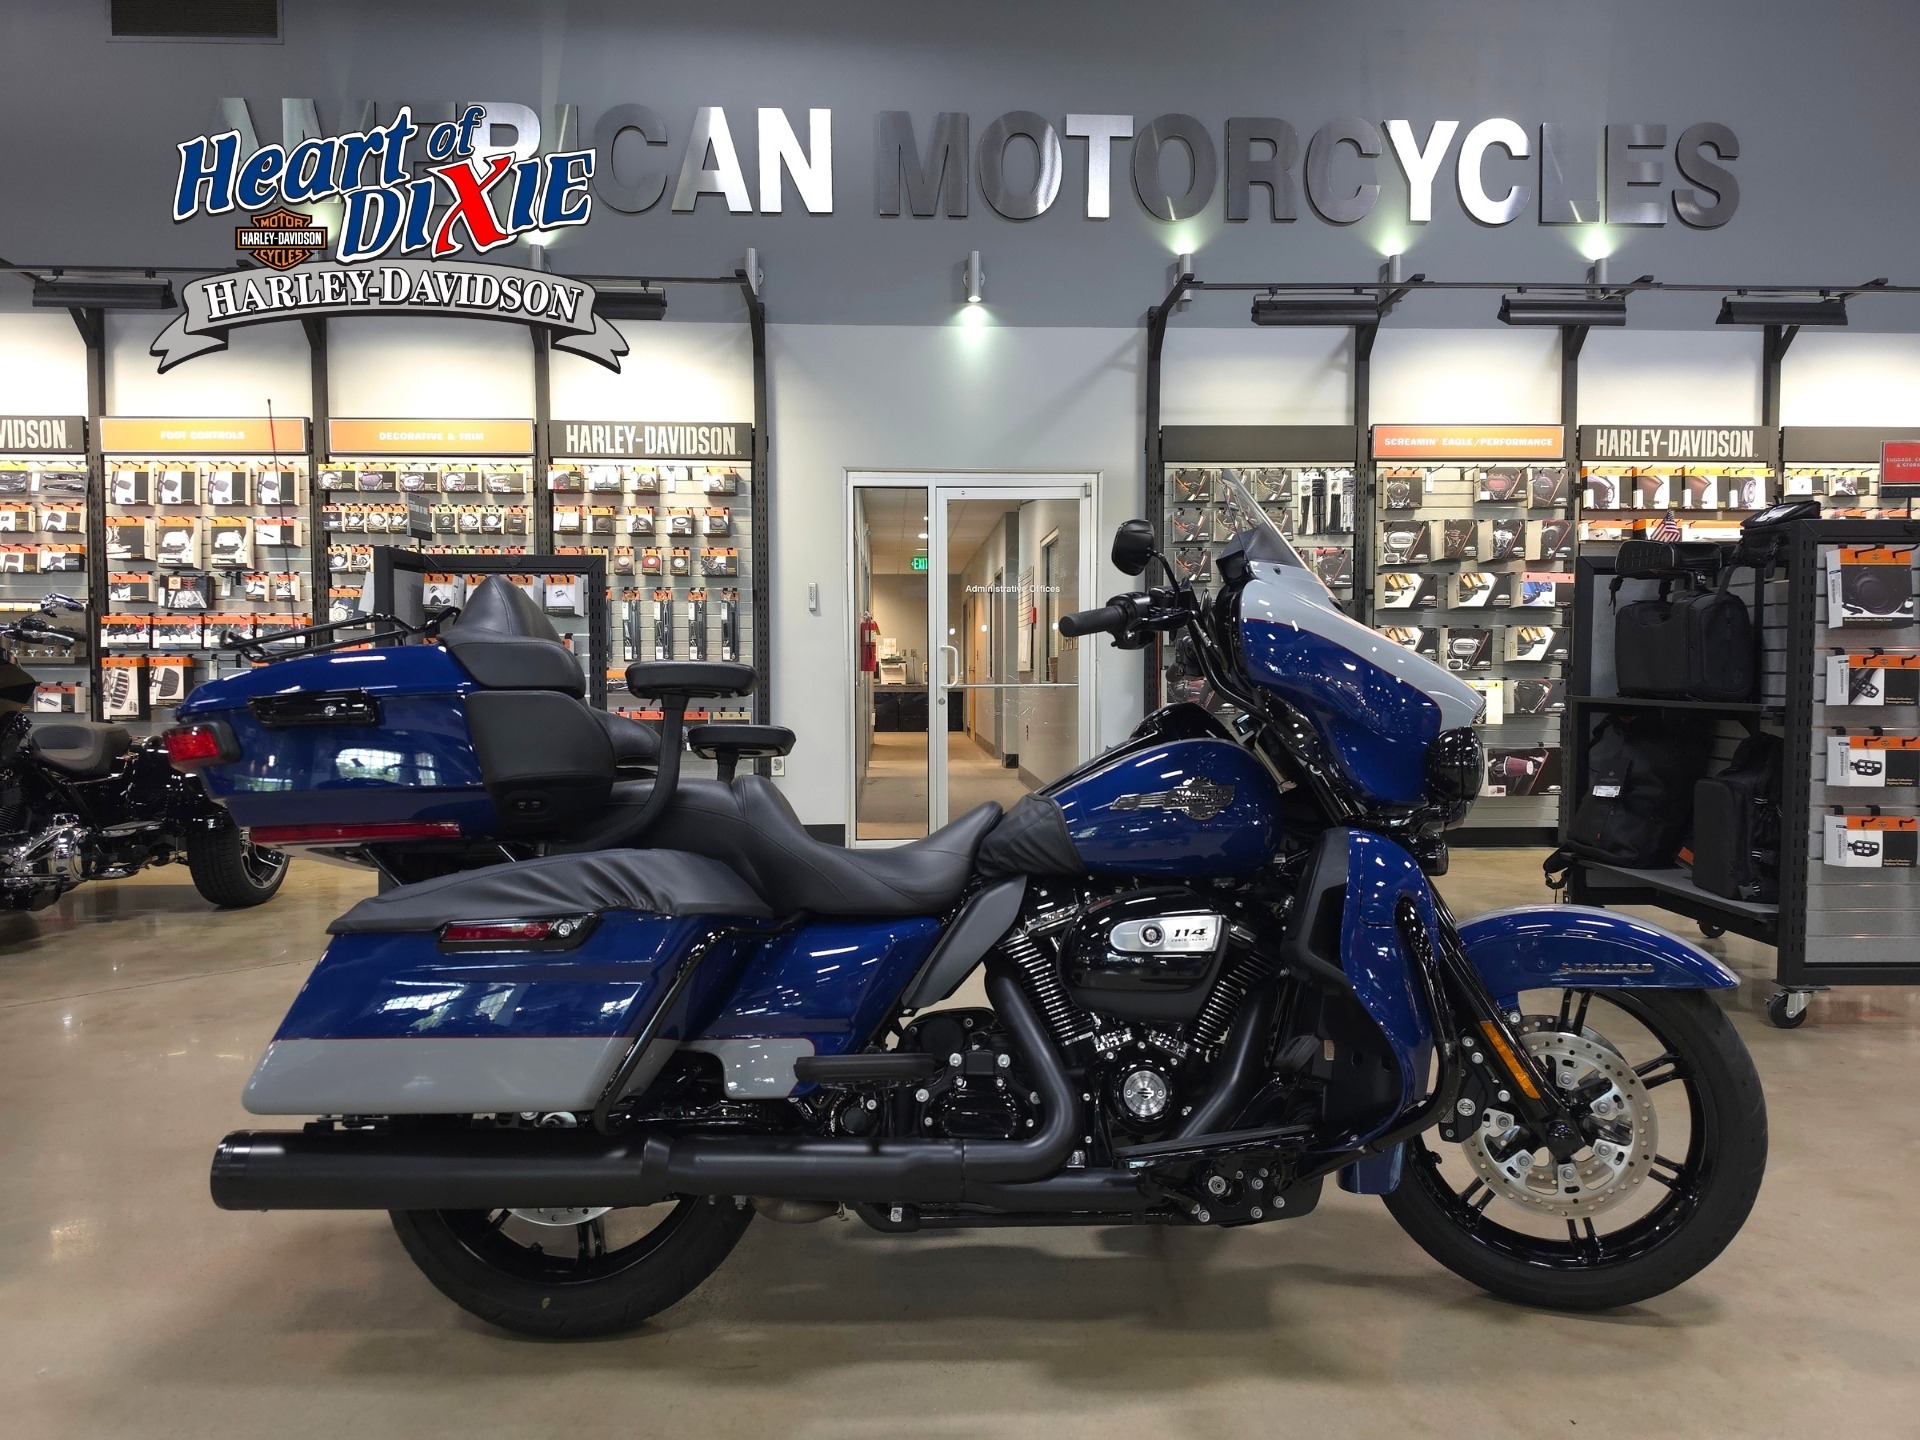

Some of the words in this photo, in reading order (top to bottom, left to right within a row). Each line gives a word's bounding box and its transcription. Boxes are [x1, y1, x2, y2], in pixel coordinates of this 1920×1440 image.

[879, 110, 1741, 228] MOTORCYCLES
[161, 430, 187, 440] FOOT
[189, 430, 245, 440] CONTROLS
[379, 432, 444, 441] DECORATIVE
[447, 432, 455, 441] &
[458, 432, 484, 441] TRIM
[565, 424, 736, 456] HARLEY-DAVIDSON
[1595, 428, 1754, 458] HARLEY-DAVIDSON
[965, 584, 1026, 593] Administrative
[1029, 584, 1061, 593] Offices
[1174, 927, 1207, 938] 114
